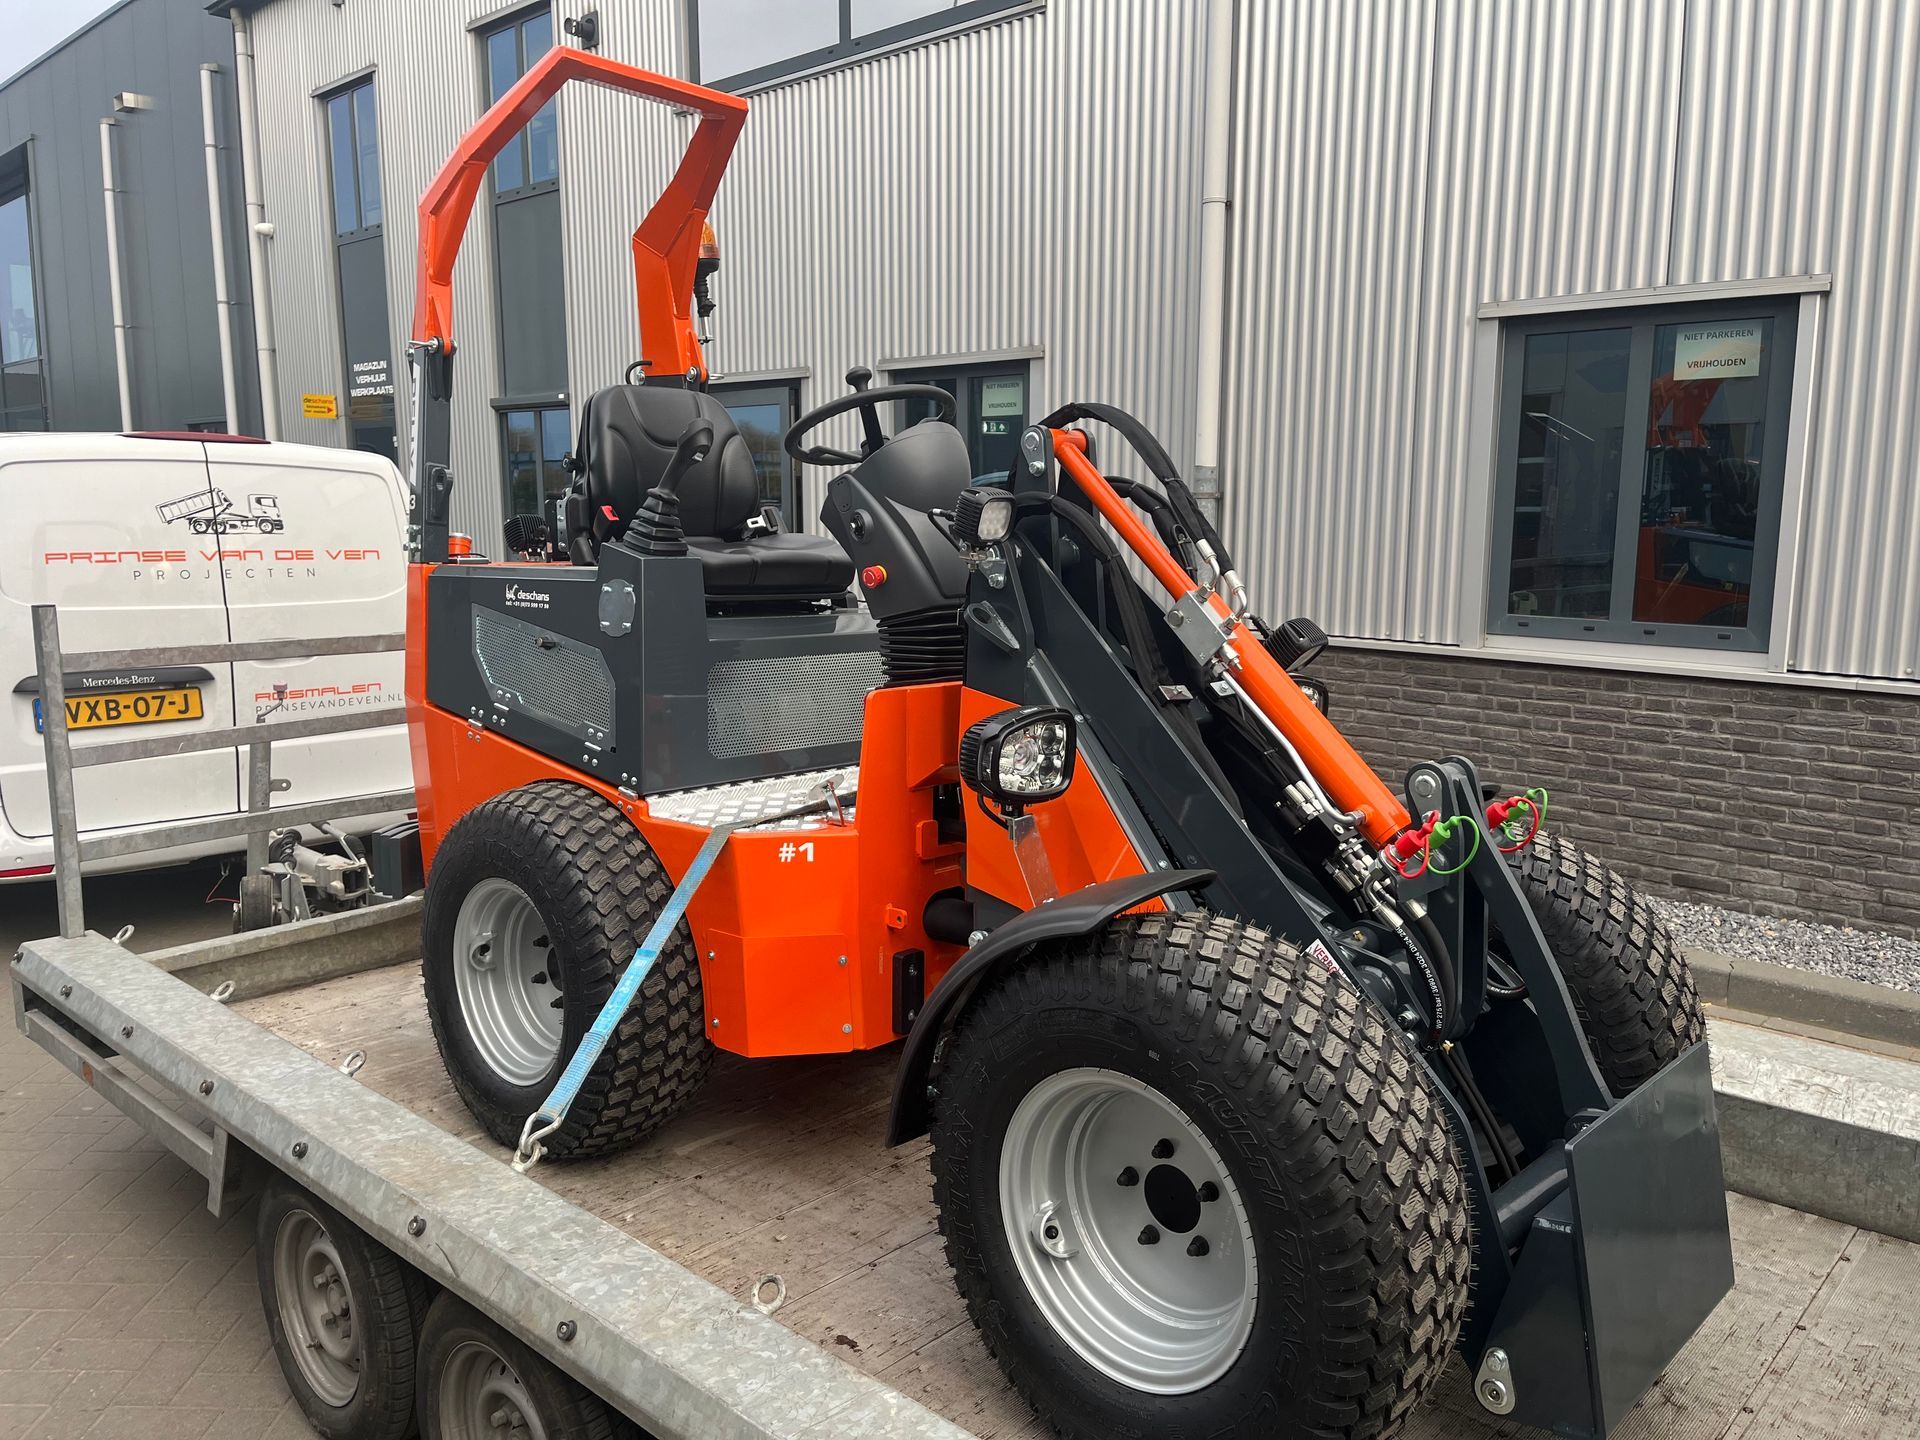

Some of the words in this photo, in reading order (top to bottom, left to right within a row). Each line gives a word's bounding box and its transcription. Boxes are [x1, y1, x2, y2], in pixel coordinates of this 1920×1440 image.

[1684, 332, 1704, 341] NIET
[1706, 329, 1754, 339] PARKEREN
[353, 360, 387, 372] MAGAZIJN
[1687, 358, 1746, 368] VRIJHOUDEN
[355, 373, 386, 384] VERHUUR
[350, 385, 394, 397] WERKPLAATS
[45, 550, 187, 565] PRINSE
[199, 550, 263, 562] VAN
[275, 550, 314, 561] DE
[326, 549, 380, 561] VEN
[133, 568, 316, 581] PROJECTEN
[517, 590, 550, 602] deschans
[83, 675, 156, 688] Mercedes-Benz
[255, 683, 382, 702] ROSMALEN
[65, 693, 191, 724] VXB-07-J
[778, 842, 814, 862] #1
